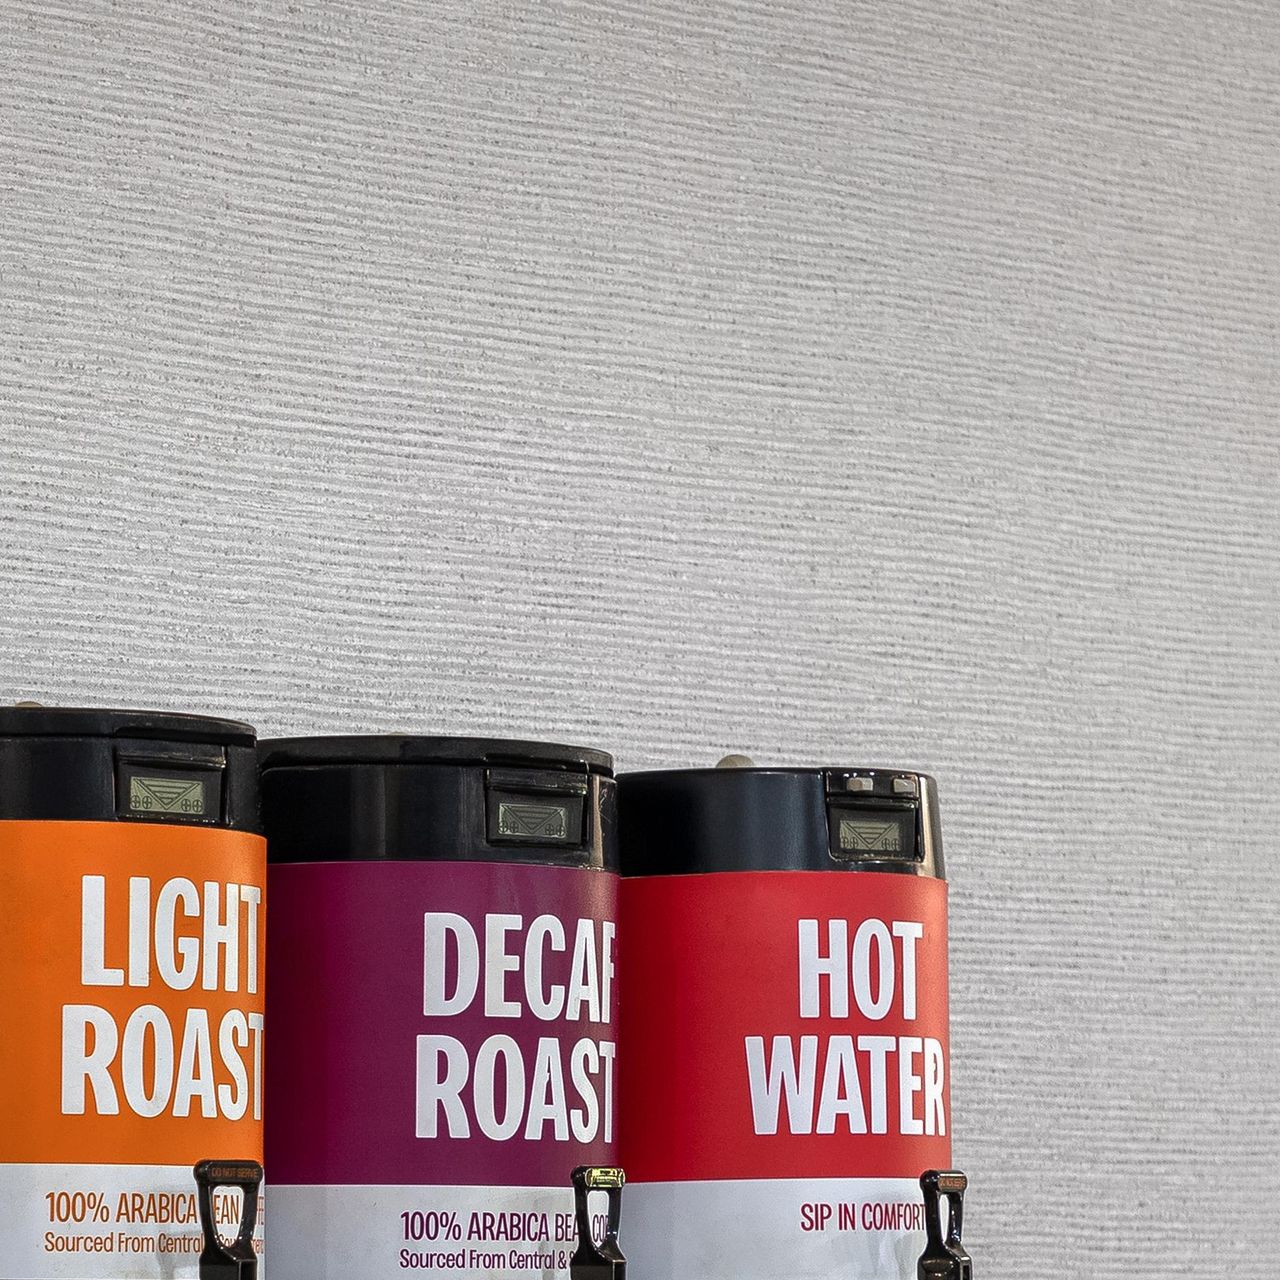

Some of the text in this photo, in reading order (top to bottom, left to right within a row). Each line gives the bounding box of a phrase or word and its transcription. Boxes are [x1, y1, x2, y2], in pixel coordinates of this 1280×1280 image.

[81, 875, 261, 994] LIGHT
[423, 912, 615, 1023] DECAF
[798, 919, 924, 1020] HOT
[61, 1004, 264, 1121] ROAST
[416, 1034, 616, 1144] ROAST
[745, 1035, 946, 1136] WATER
[44, 1232, 114, 1253] Sourced
[118, 1233, 155, 1253] From
[158, 1233, 204, 1254] Central
[45, 1191, 110, 1223] 100%
[116, 1193, 198, 1224] ARABICA
[213, 1194, 239, 1225] EAN
[400, 1211, 462, 1241] 100%
[467, 1212, 549, 1242] ARABICA
[555, 1213, 580, 1242] BEA
[801, 1203, 832, 1231] SIP
[838, 1203, 856, 1231] IN
[399, 1249, 466, 1269] Sourced
[469, 1250, 506, 1269] From
[509, 1250, 555, 1270] Central
[558, 1251, 567, 1270] &
